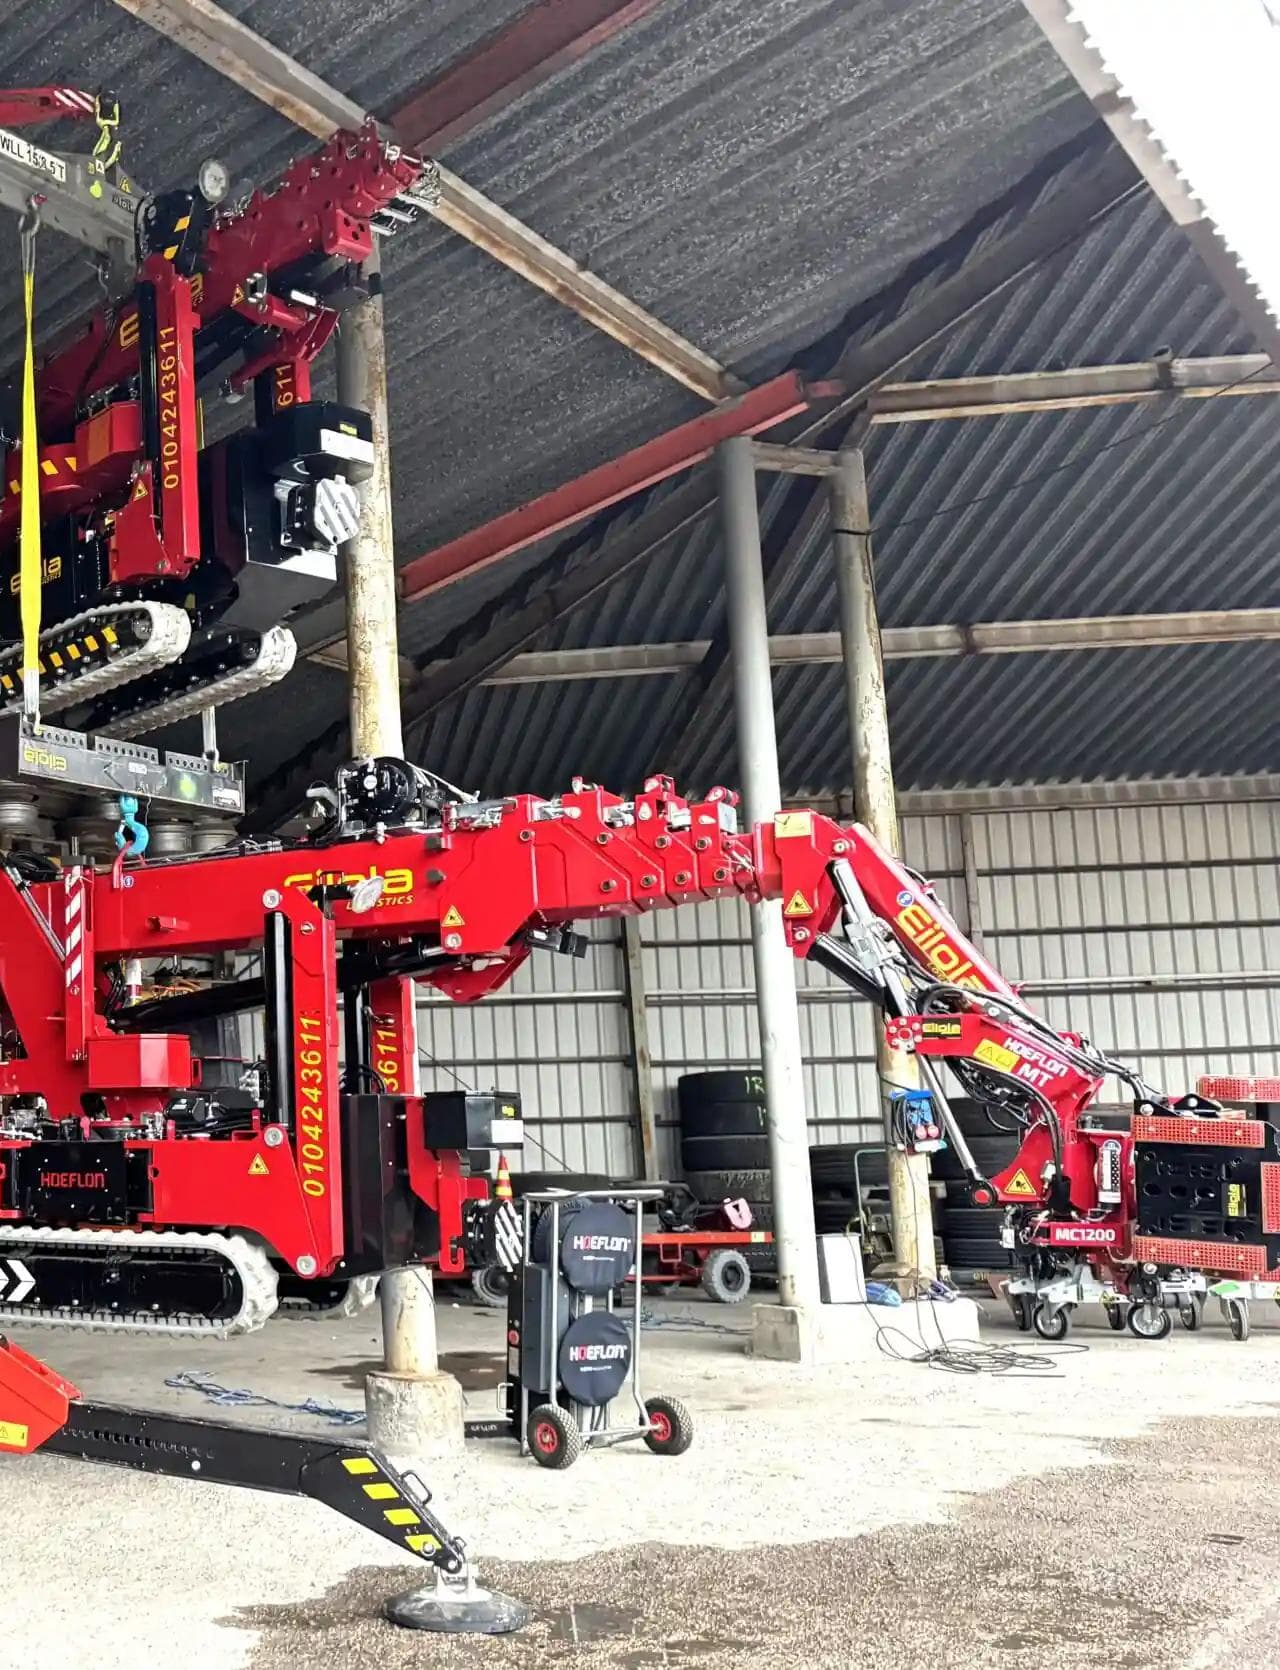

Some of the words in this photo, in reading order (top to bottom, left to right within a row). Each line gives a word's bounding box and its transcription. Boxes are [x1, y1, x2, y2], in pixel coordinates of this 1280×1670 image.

[0, 135, 24, 159] WLL
[158, 326, 180, 489] 0104243611
[1003, 1037, 1069, 1077] HOEFLON
[1017, 1063, 1054, 1087] MT
[298, 1015, 325, 1197] 0104243611
[40, 1172, 105, 1189] HOEFLON
[573, 1235, 628, 1252] HOEFLON
[1055, 1228, 1116, 1242] MC1200
[569, 1344, 625, 1361] HOEFLON
